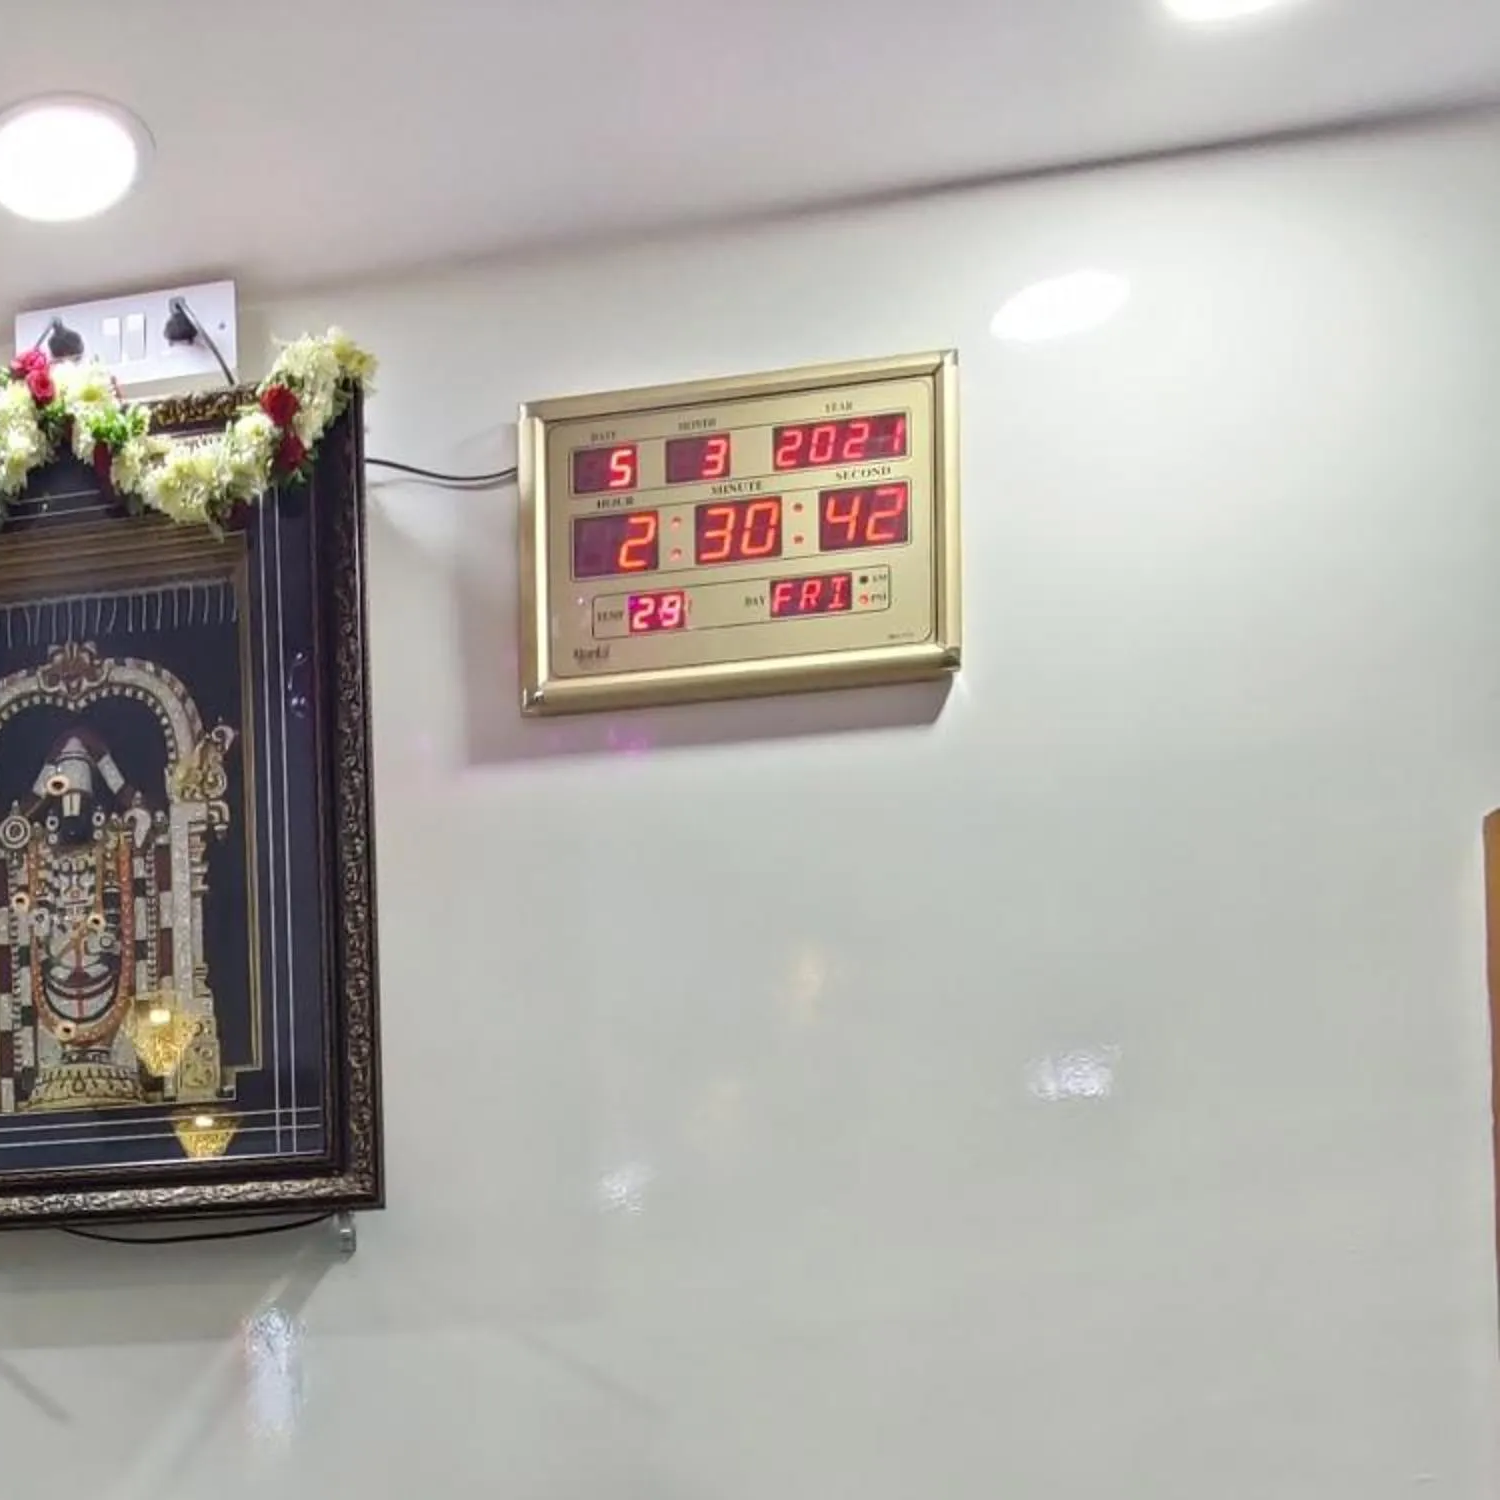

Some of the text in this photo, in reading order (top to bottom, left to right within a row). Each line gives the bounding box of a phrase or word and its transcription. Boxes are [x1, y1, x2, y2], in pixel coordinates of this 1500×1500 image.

[701, 438, 728, 478] 3
[775, 418, 906, 468] 2021
[609, 448, 634, 488] 5
[835, 465, 892, 481] SECOND
[711, 481, 764, 495] MINUTE
[772, 575, 849, 614] FRI
